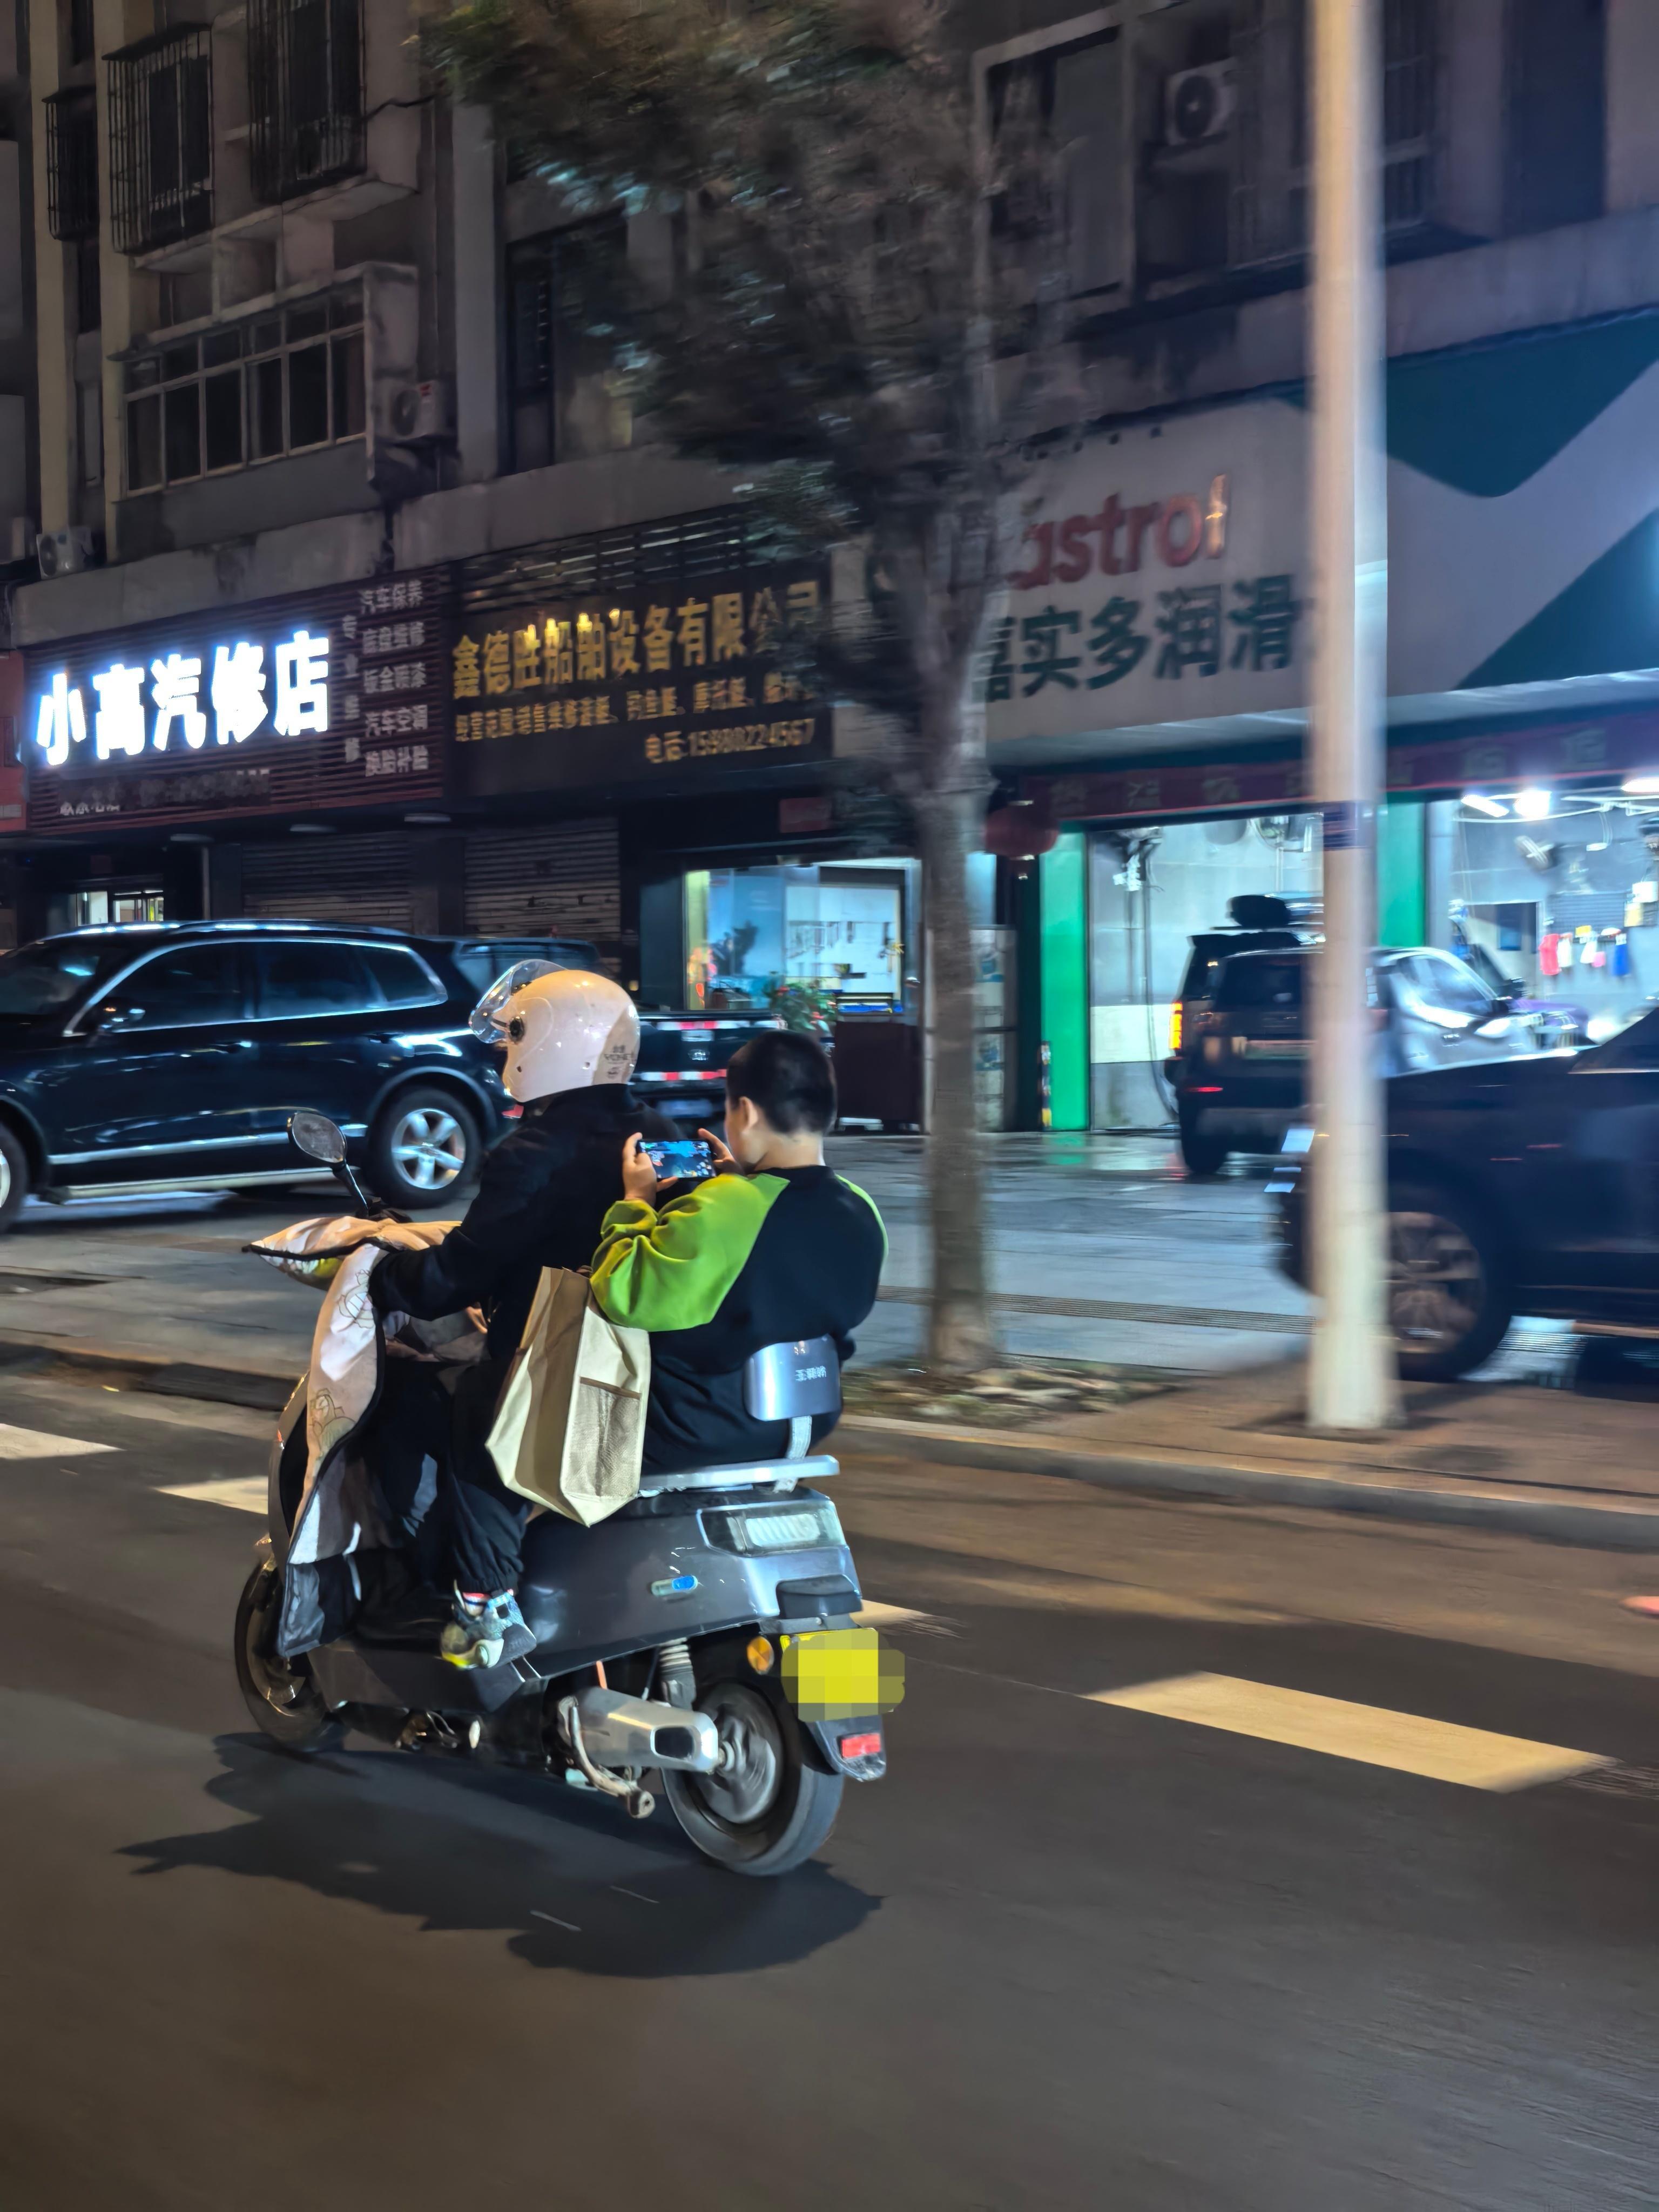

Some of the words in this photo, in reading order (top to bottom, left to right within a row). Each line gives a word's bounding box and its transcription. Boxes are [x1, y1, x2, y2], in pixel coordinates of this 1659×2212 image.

[1006, 473, 1227, 590] astrol
[36, 630, 330, 766] 小高汽修店
